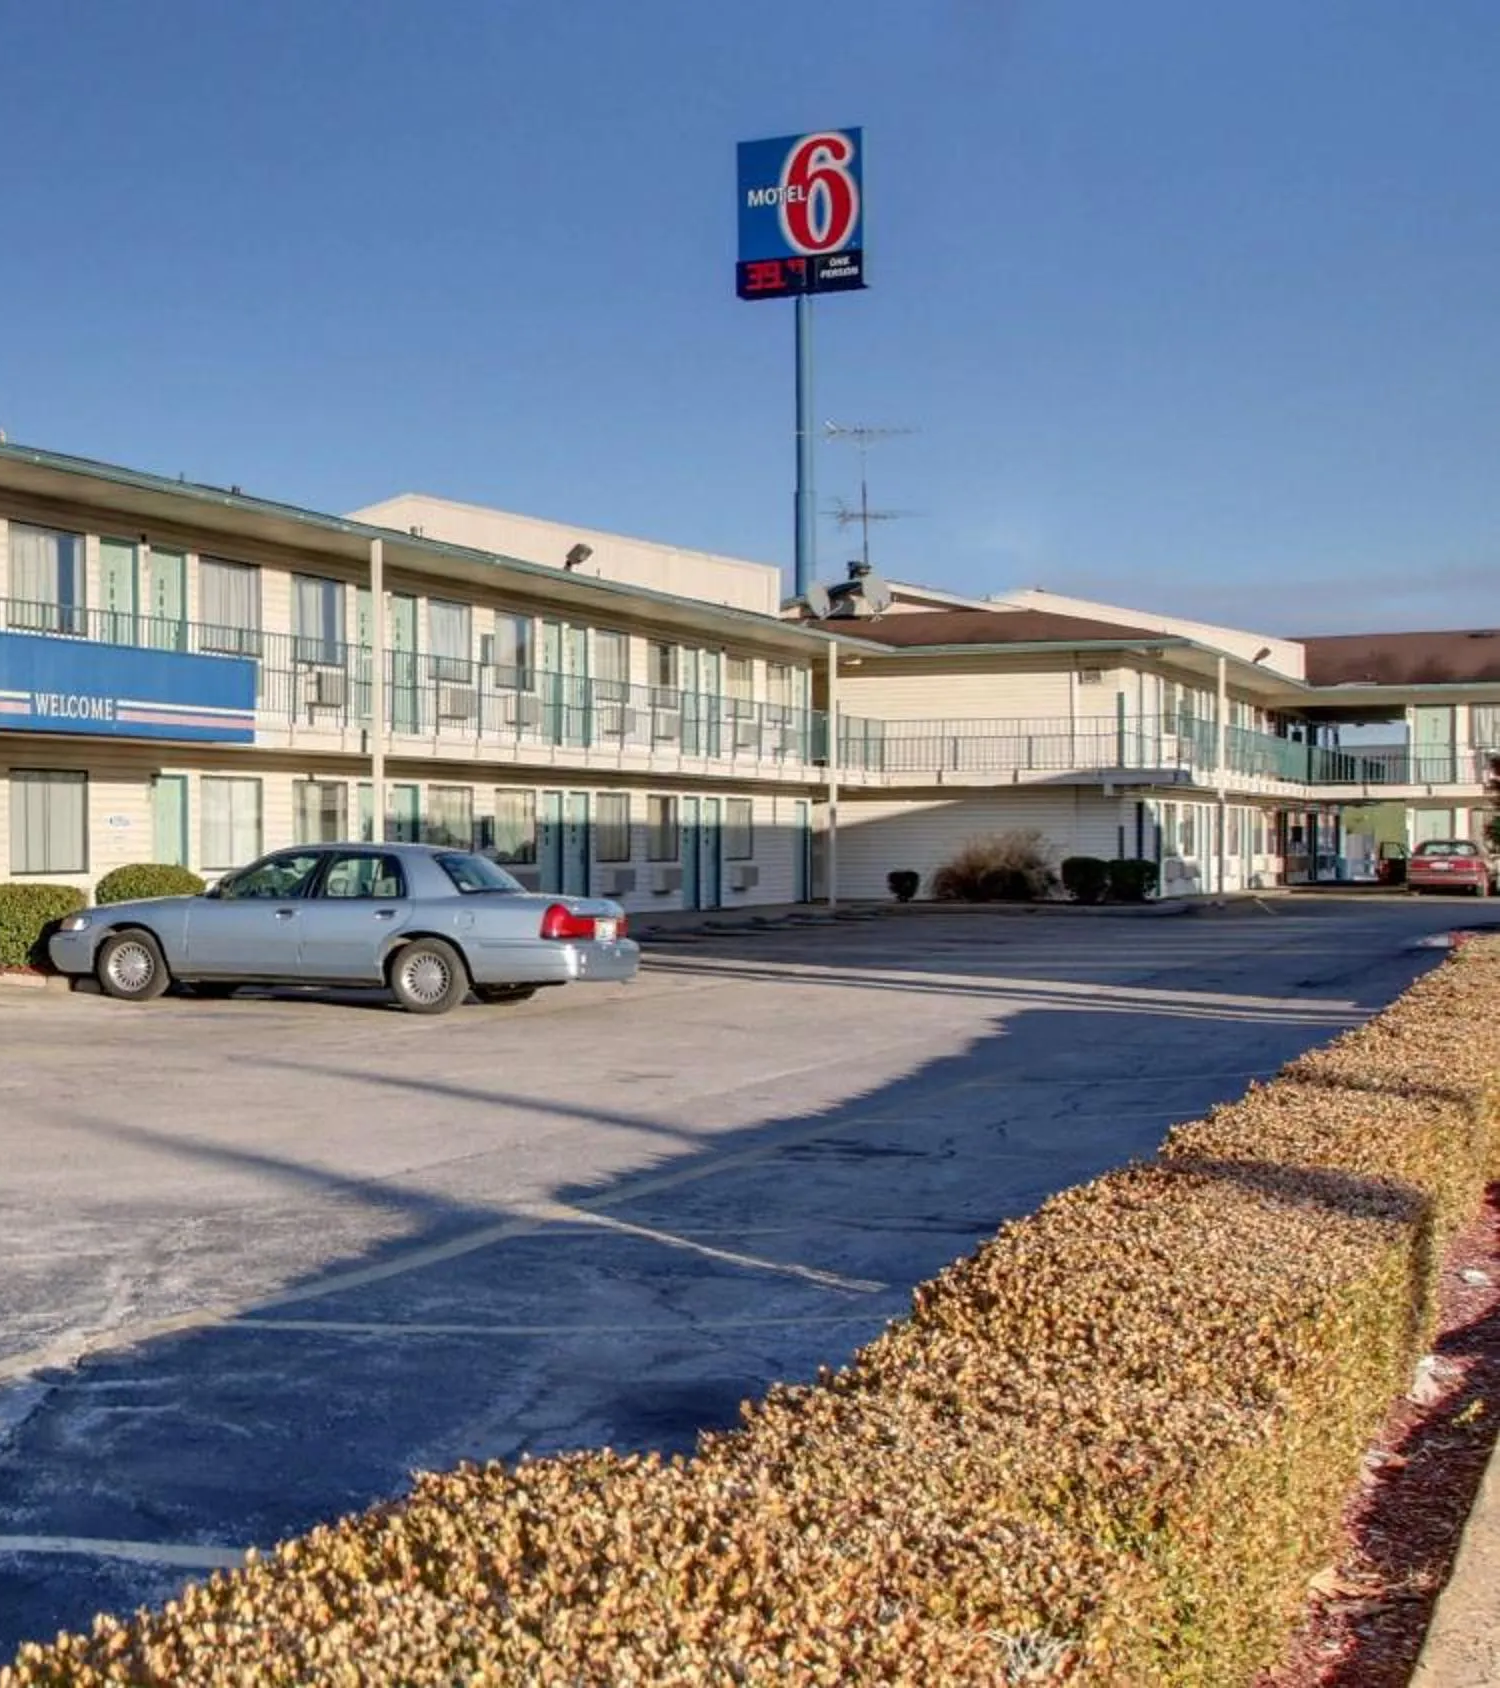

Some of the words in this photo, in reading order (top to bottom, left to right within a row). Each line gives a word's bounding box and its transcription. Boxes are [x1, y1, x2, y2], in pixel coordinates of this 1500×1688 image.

[747, 184, 806, 207] MOTEL
[778, 131, 859, 256] 6
[35, 693, 115, 721] WELCOME
